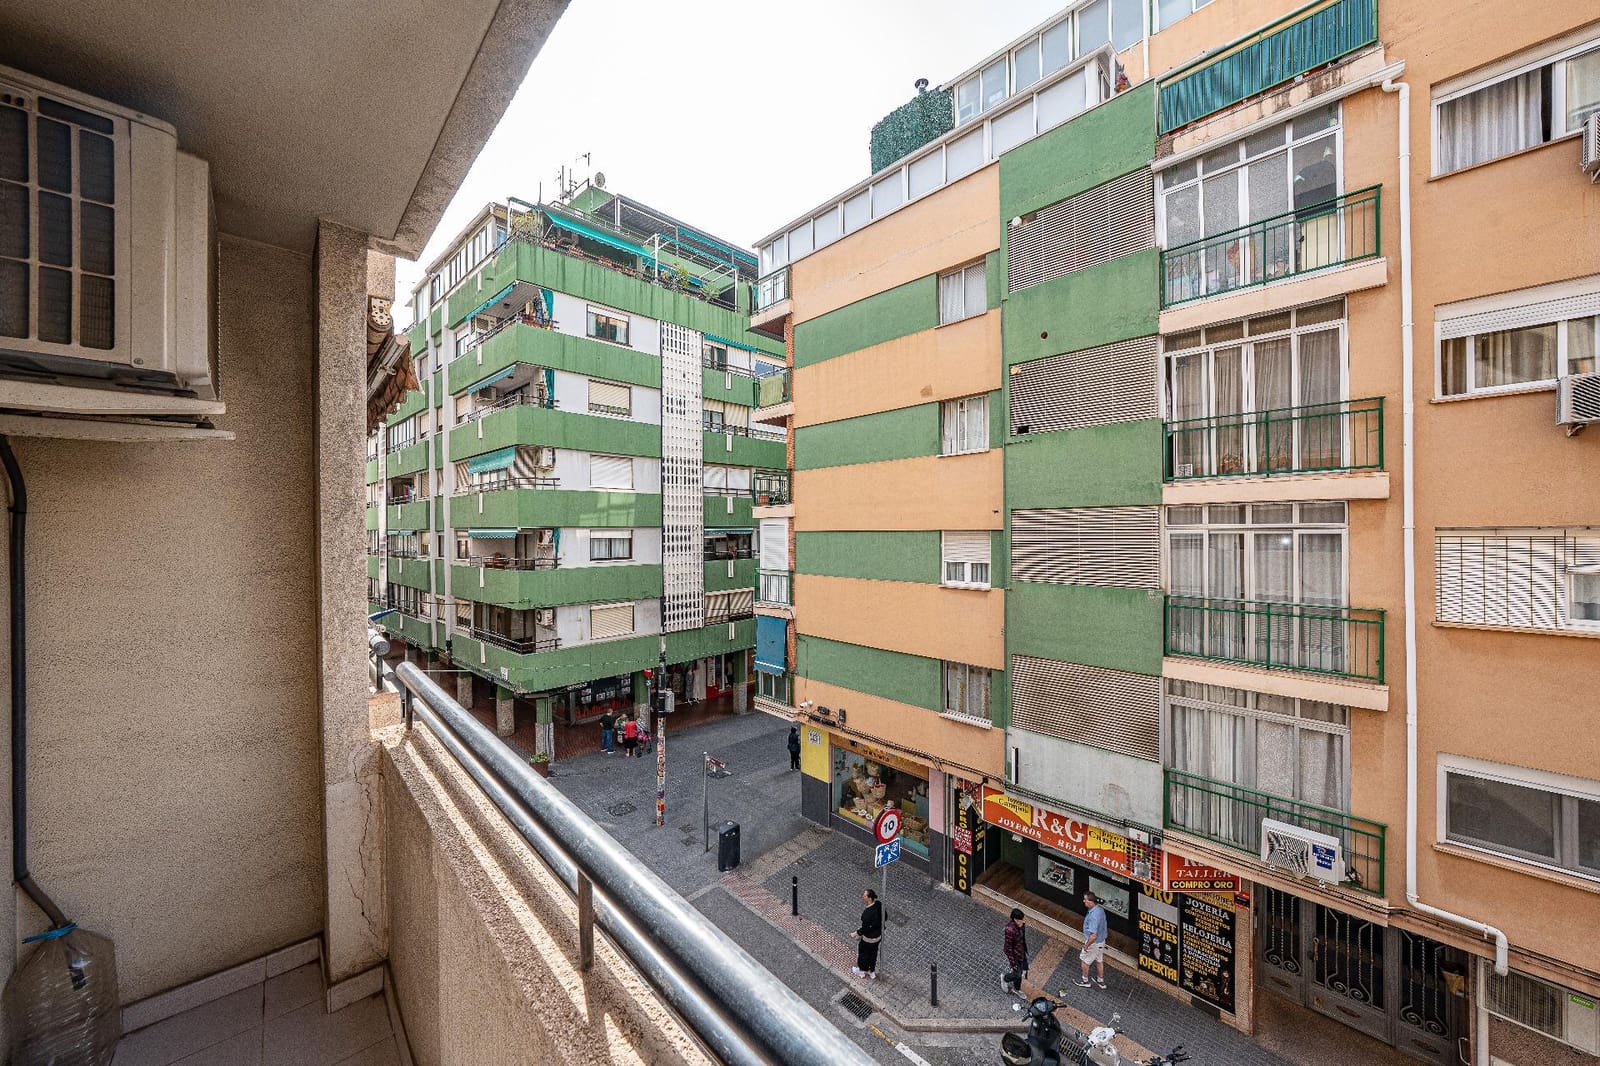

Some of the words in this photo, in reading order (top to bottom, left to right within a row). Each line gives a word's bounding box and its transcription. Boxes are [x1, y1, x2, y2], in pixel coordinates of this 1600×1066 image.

[884, 820, 895, 833] 10
[998, 816, 1042, 839] JOYEROS
[1032, 805, 1084, 843] R&G
[1057, 839, 1127, 871] RELOJEROS
[958, 853, 967, 890] ORO
[1176, 868, 1232, 878] TALLER
[1172, 880, 1211, 889] COMPRO
[1213, 880, 1234, 889] ORO
[1139, 920, 1178, 945] RELOJES
[1140, 911, 1177, 933] OUTLET
[1182, 922, 1233, 950] RELOJERÍA
[1139, 953, 1178, 981] ¡OFERTA!
